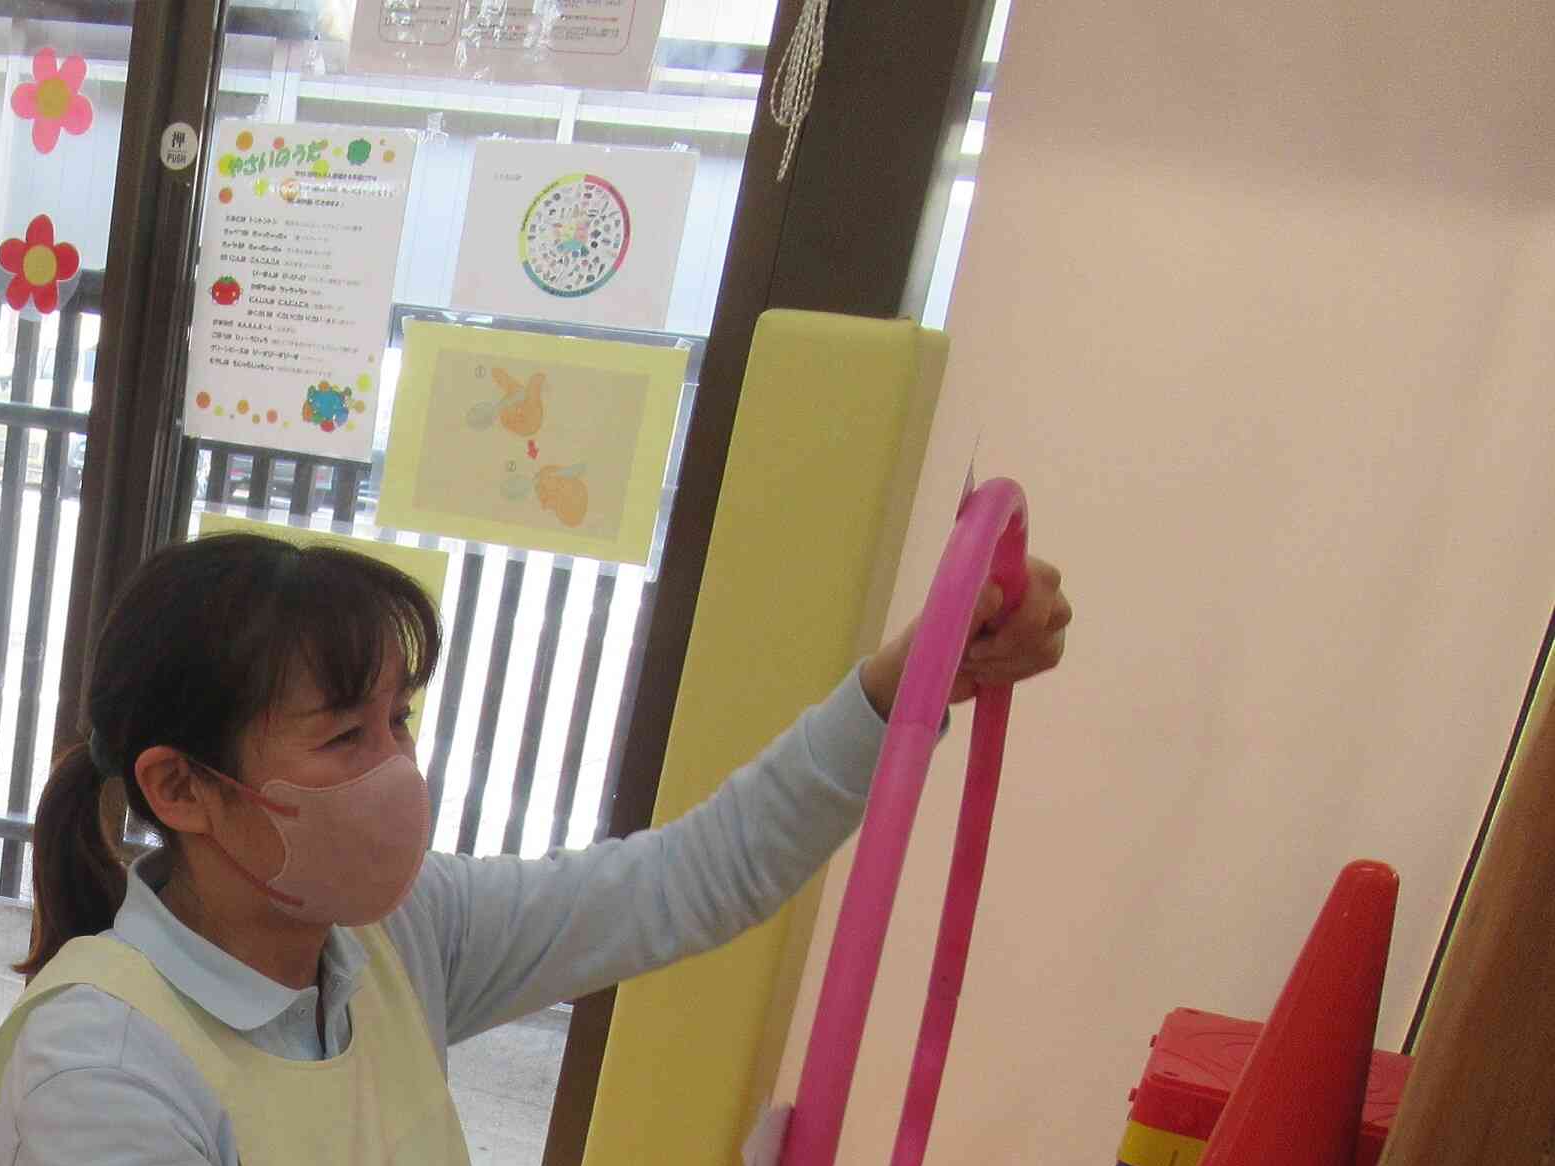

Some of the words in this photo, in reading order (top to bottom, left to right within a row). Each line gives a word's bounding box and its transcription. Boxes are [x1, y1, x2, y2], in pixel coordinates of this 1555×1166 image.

[171, 131, 186, 148] 押
[166, 152, 187, 164] PUSH
[229, 143, 321, 177] やさいのうた
